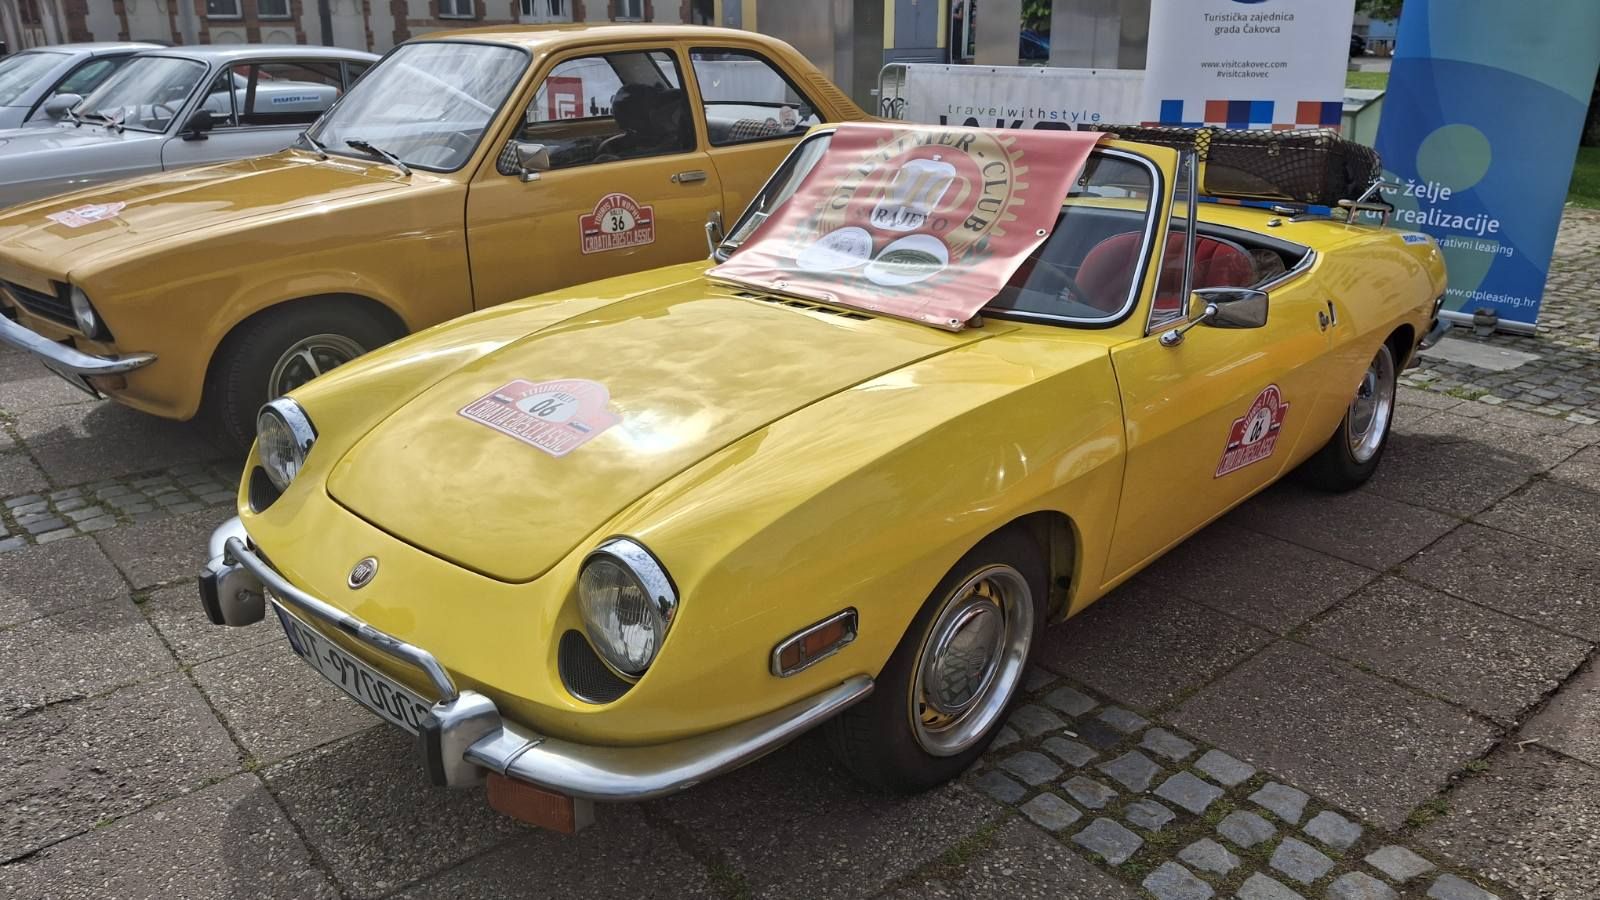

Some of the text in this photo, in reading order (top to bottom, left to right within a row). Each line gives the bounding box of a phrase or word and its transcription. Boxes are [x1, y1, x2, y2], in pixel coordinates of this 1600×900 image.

[1203, 12, 1295, 23] Turistička zajednica
[1214, 23, 1281, 36] grada Čakovca
[1200, 60, 1289, 69] www.visitcakovec.com
[1216, 69, 1270, 79] #visitcakovec
[948, 104, 1101, 123] travelwithstyle
[1403, 178, 1452, 203] želje
[611, 216, 625, 232] 36
[1396, 208, 1500, 236] realizacije
[585, 234, 612, 252] CROATIA
[1475, 241, 1514, 258] leasing
[466, 400, 518, 426] CROATIA
[529, 398, 565, 417] 06
